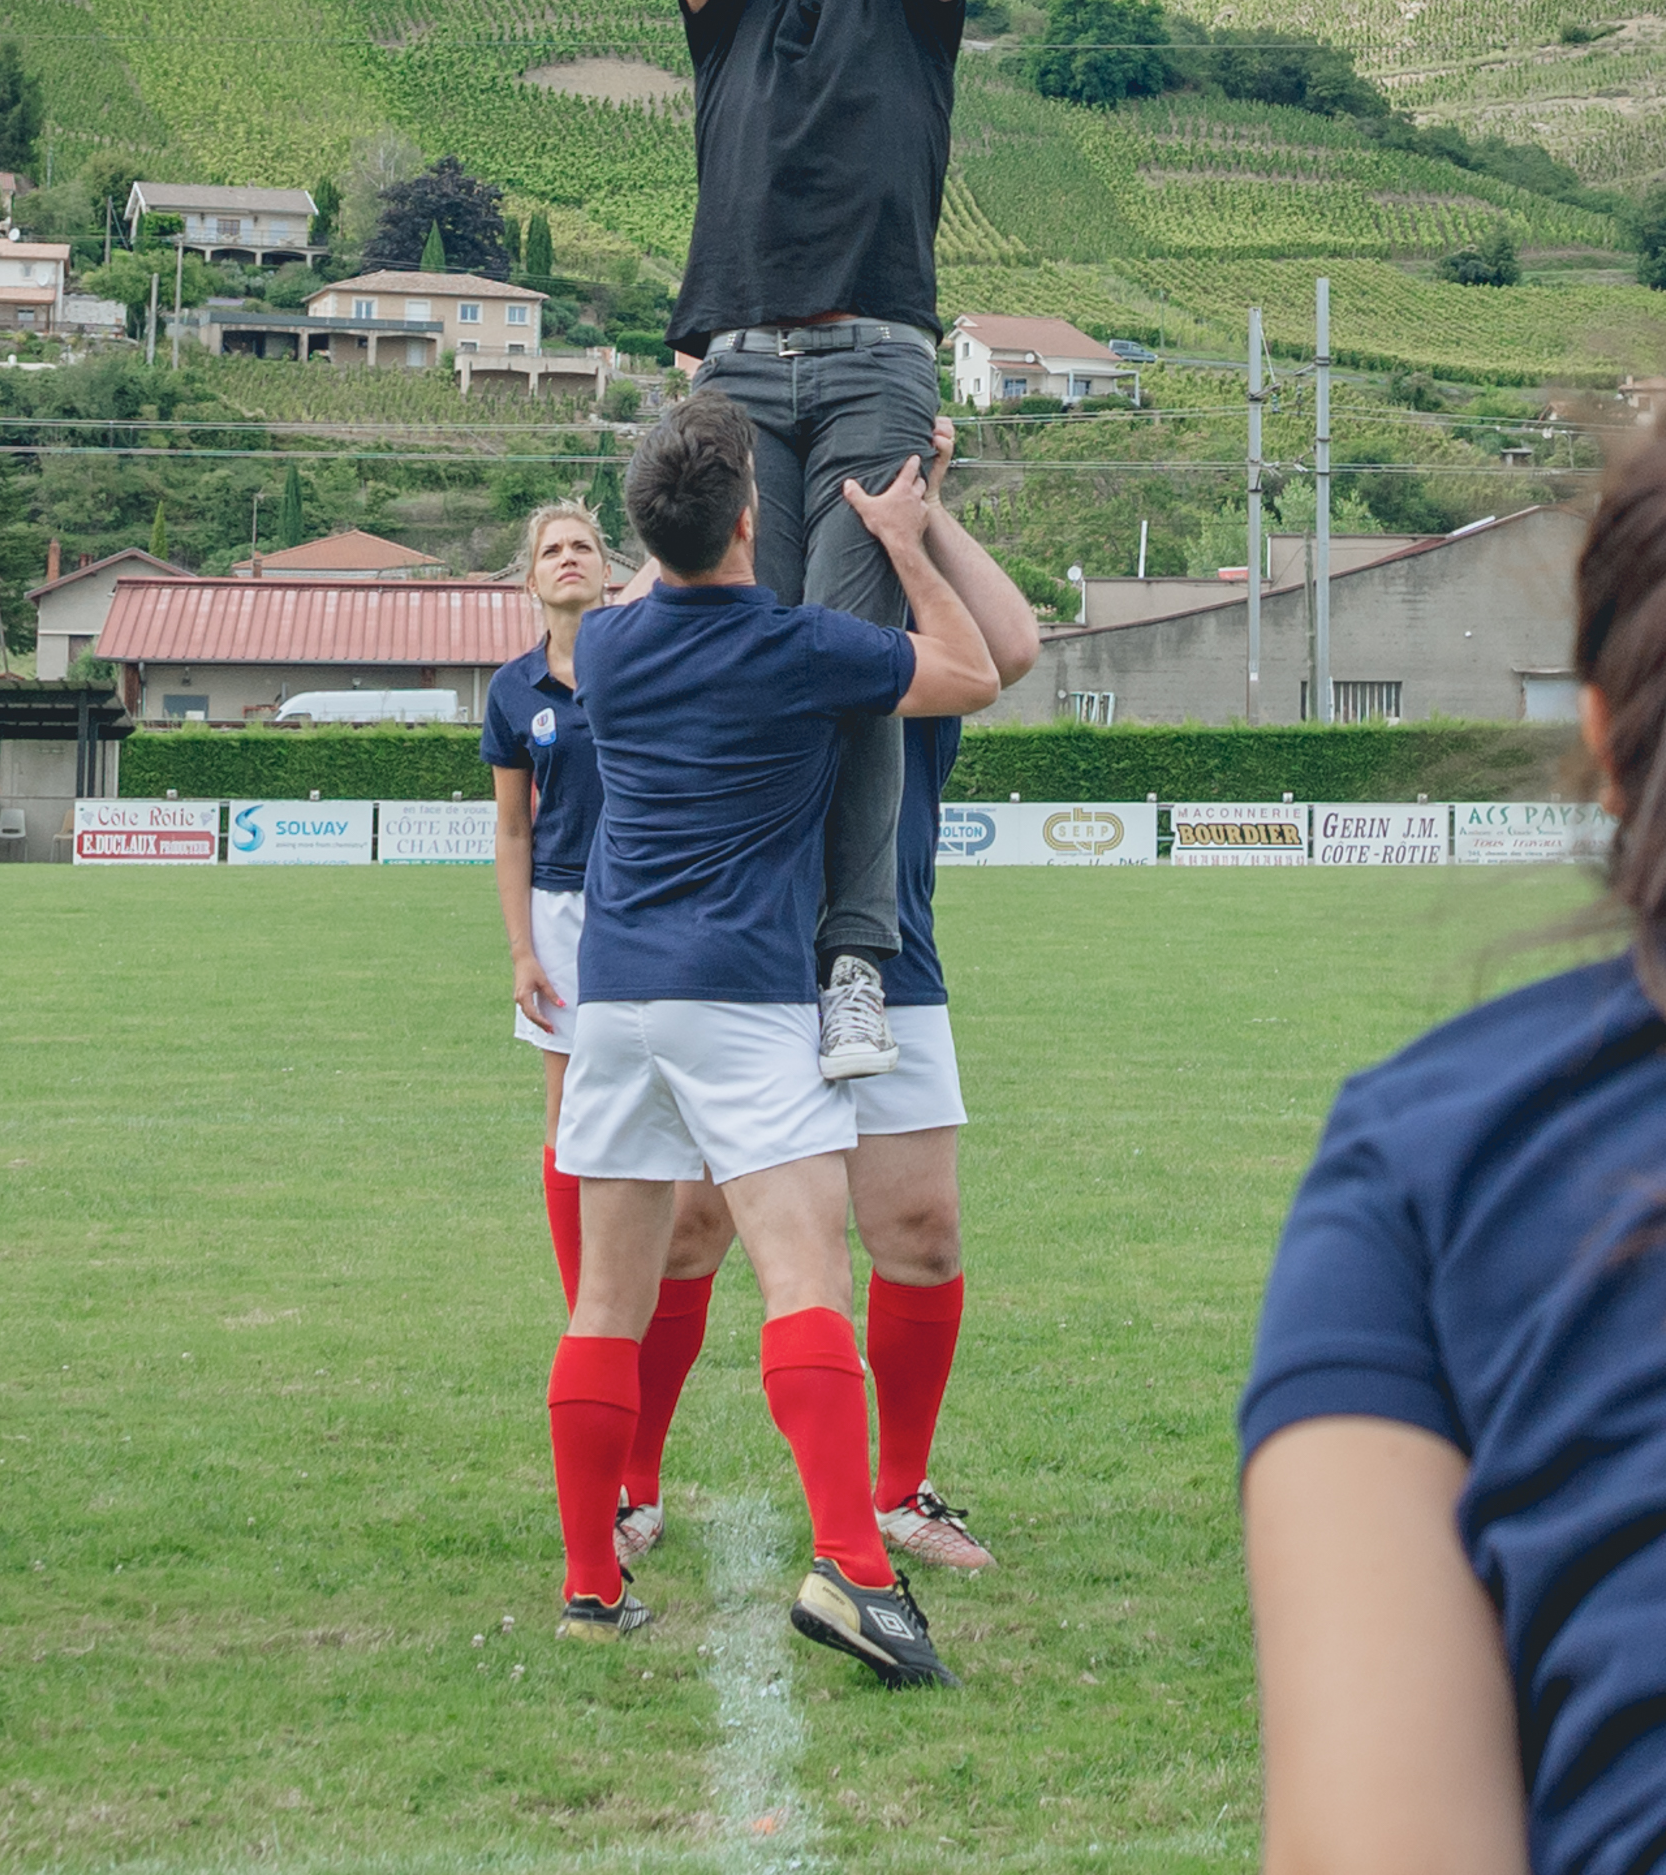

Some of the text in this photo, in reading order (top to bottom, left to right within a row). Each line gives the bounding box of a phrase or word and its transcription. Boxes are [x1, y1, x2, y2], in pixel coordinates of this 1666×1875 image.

[97, 805, 195, 826] Côte Rôtie
[1322, 812, 1391, 839] GERIN
[1402, 817, 1439, 839] J.M.
[275, 820, 349, 836] SOLVAY
[385, 816, 498, 836] CÔTE RÔTI
[939, 826, 983, 838] OLTON
[1058, 826, 1109, 837] SERP
[1176, 822, 1303, 846] BOURDIER
